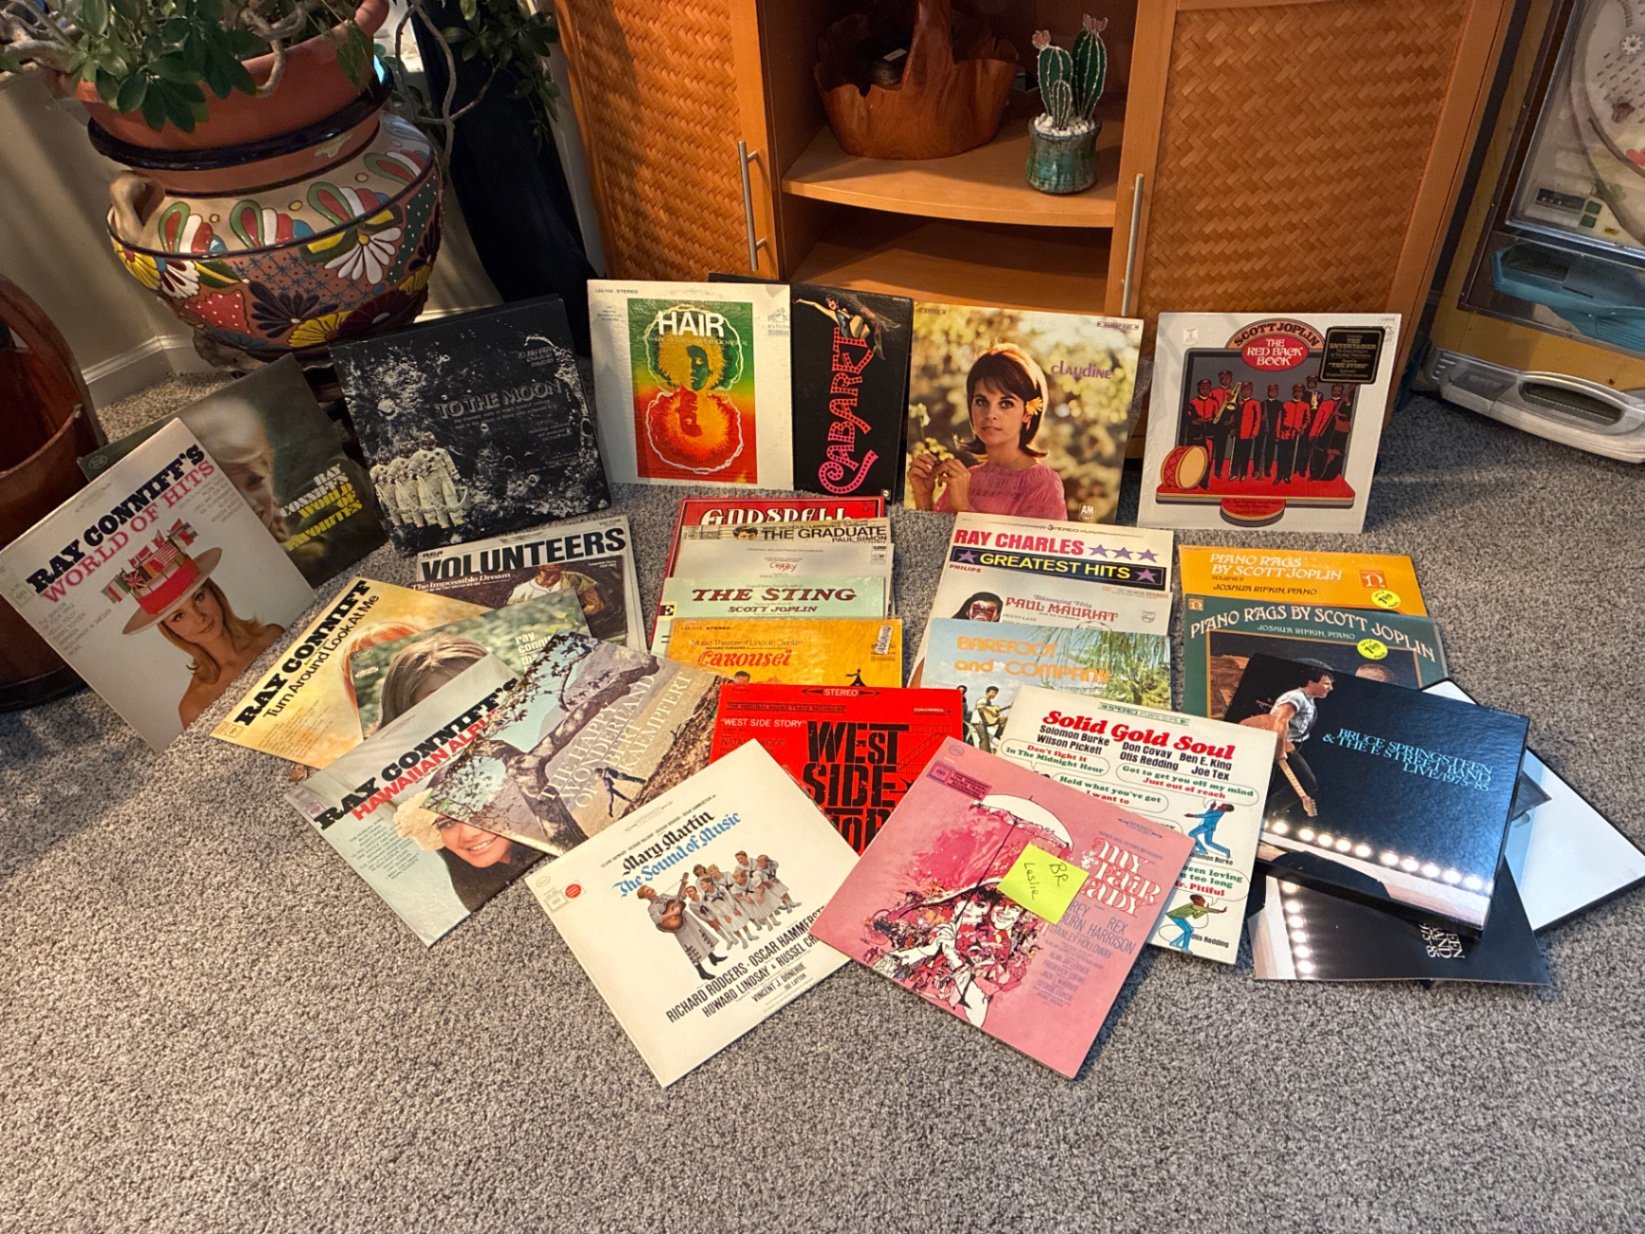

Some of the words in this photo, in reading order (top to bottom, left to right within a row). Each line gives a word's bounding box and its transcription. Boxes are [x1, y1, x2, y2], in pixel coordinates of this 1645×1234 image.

[657, 310, 725, 337] HAIR
[1234, 323, 1277, 346] SCOTT
[1277, 323, 1320, 346] JOPLIN
[1247, 347, 1270, 356] RED
[1272, 347, 1303, 356] BACK
[1265, 338, 1285, 347] THE
[1256, 356, 1292, 366] BOOK
[434, 400, 465, 419] TO
[464, 392, 500, 413] THE
[502, 378, 563, 405] MOON
[818, 326, 879, 494] CABARET
[26, 539, 86, 594] RAY
[83, 444, 205, 547] CONNIFF'S
[41, 533, 129, 604] WORLD
[130, 504, 158, 533] OF
[162, 459, 215, 509] HITS
[761, 530, 795, 541] THE
[798, 526, 887, 540] GRADUATE
[954, 529, 992, 546] RAY
[995, 533, 1085, 556] CHARLES
[421, 527, 627, 580] VOLUNTEERS
[980, 552, 1081, 575] GREATEST
[1084, 562, 1131, 579] HITS
[1210, 553, 1257, 565] PIANO
[1260, 555, 1302, 568] RAGS
[950, 564, 982, 573] PHILIPS
[1211, 564, 1233, 575] BY
[1233, 566, 1286, 578] SCOTT
[1286, 568, 1343, 581] JOPLIN
[692, 588, 753, 601] THE
[761, 588, 858, 602] STING
[1212, 584, 1252, 592] JOSHUA
[728, 605, 771, 613] SCOTT
[771, 605, 818, 613] JOPLIN
[1005, 596, 1045, 611] PAUL
[1048, 603, 1119, 622] MAURIAT
[515, 632, 535, 645] ray
[518, 635, 552, 653] conni
[1190, 610, 1240, 639] PIANO
[1244, 605, 1287, 623] RAGS
[1291, 606, 1310, 622] BY
[1314, 608, 1368, 632] SCOTT
[1371, 622, 1436, 663] JOPLIN
[1257, 624, 1293, 634] JOSHUA
[1327, 632, 1356, 640] PIANO
[234, 672, 289, 727] RAY
[281, 579, 370, 674] CONNIFF
[263, 693, 295, 718] Turn
[287, 651, 329, 694] Around
[323, 626, 352, 656] Look
[348, 611, 364, 626] At
[361, 594, 380, 614] Me
[956, 636, 1056, 658] BAREFOOT
[954, 659, 994, 673] and
[823, 688, 858, 697] STEREO
[617, 671, 692, 772] KAEMPFERT
[750, 718, 771, 727] SIDE
[1042, 710, 1108, 735] Solid
[1110, 724, 1170, 747] Gold
[1173, 735, 1236, 760] Soul
[559, 675, 656, 799] WONDERLAND
[806, 721, 909, 765] WEST
[1036, 734, 1070, 749] Wilson
[1071, 741, 1102, 756] Pickett
[1039, 724, 1080, 741] Solomon
[1080, 732, 1110, 747] Burke
[539, 761, 576, 799] THE
[568, 705, 618, 762] HAPPY
[1018, 748, 1034, 758] The
[1036, 753, 1077, 768] Midnight
[1079, 763, 1104, 773] Hour
[1027, 744, 1052, 755] Don't
[1122, 741, 1143, 753] Don
[1143, 745, 1173, 759] Covay
[1179, 752, 1199, 764] Ben
[1200, 756, 1209, 766] E.
[1210, 758, 1232, 771] King
[1322, 733, 1336, 744] &
[1338, 736, 1367, 752] THE
[1370, 745, 1381, 755] E
[1383, 749, 1441, 773] STREET
[1447, 763, 1492, 783] BAND
[1337, 728, 1386, 749] BRUCE
[1387, 741, 1493, 775] SPRINGSTEEN
[574, 781, 598, 808] OF
[603, 719, 642, 767] BERT
[1119, 751, 1144, 763] Otis
[1144, 756, 1179, 771] Redding
[1191, 765, 1211, 777] Joe
[1212, 770, 1230, 781] Tex
[351, 748, 451, 821] HAWAIIAN
[802, 763, 901, 807] SIDE
[1059, 775, 1083, 786] Hold
[1084, 781, 1109, 792] what
[1111, 788, 1144, 801] you've
[1144, 794, 1161, 804] got
[1122, 765, 1140, 774] Got
[1155, 771, 1170, 782] get
[1171, 774, 1191, 785] you
[1193, 779, 1208, 789] off
[1209, 782, 1226, 792] my
[1227, 785, 1254, 797] mind
[1142, 778, 1162, 788] Just
[1164, 782, 1182, 791] out
[1184, 786, 1195, 794] of
[1196, 787, 1226, 799] reach
[313, 776, 381, 831] RAY
[1092, 791, 1117, 803] want
[612, 875, 642, 897] The
[641, 845, 689, 881] Sound
[685, 835, 701, 853] of
[698, 812, 742, 847] Music
[622, 842, 664, 876] Mary
[662, 810, 715, 850] Martin
[1189, 874, 1207, 883] too
[1210, 877, 1233, 889] long
[1189, 882, 1225, 897] Pitiful
[1208, 869, 1243, 884] loving
[1089, 922, 1137, 956] HARRISON
[1108, 917, 1129, 935] REX
[665, 987, 708, 1023] RICHARD
[705, 962, 745, 996] RODGERS
[751, 941, 781, 968] OSCAR
[702, 988, 739, 1018] HOWARD
[736, 967, 771, 995] LINDSAY
[775, 945, 807, 967] RUSSEL
[751, 982, 776, 1003] VINCENT
